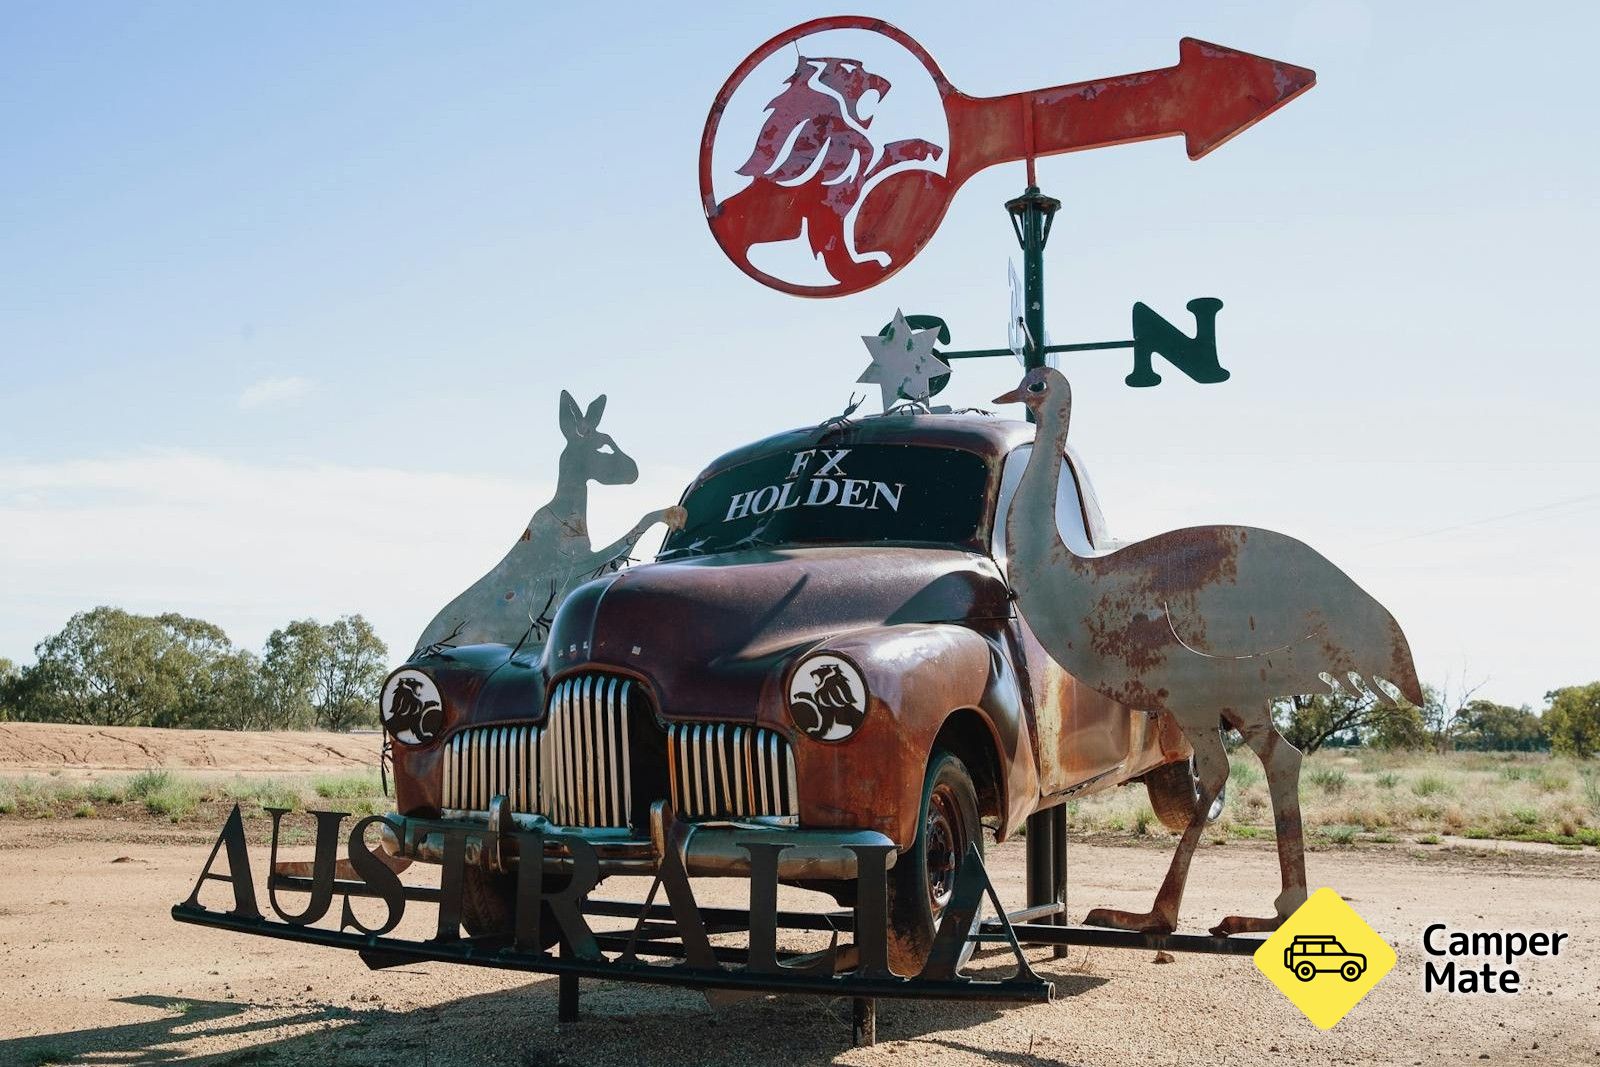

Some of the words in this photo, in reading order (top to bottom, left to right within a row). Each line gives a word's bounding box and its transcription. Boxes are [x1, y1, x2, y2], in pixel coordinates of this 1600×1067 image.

[1124, 297, 1230, 388] N
[785, 448, 853, 480] FX
[722, 478, 905, 523] HOLDEN
[185, 802, 1046, 984] AUSTRALIA
